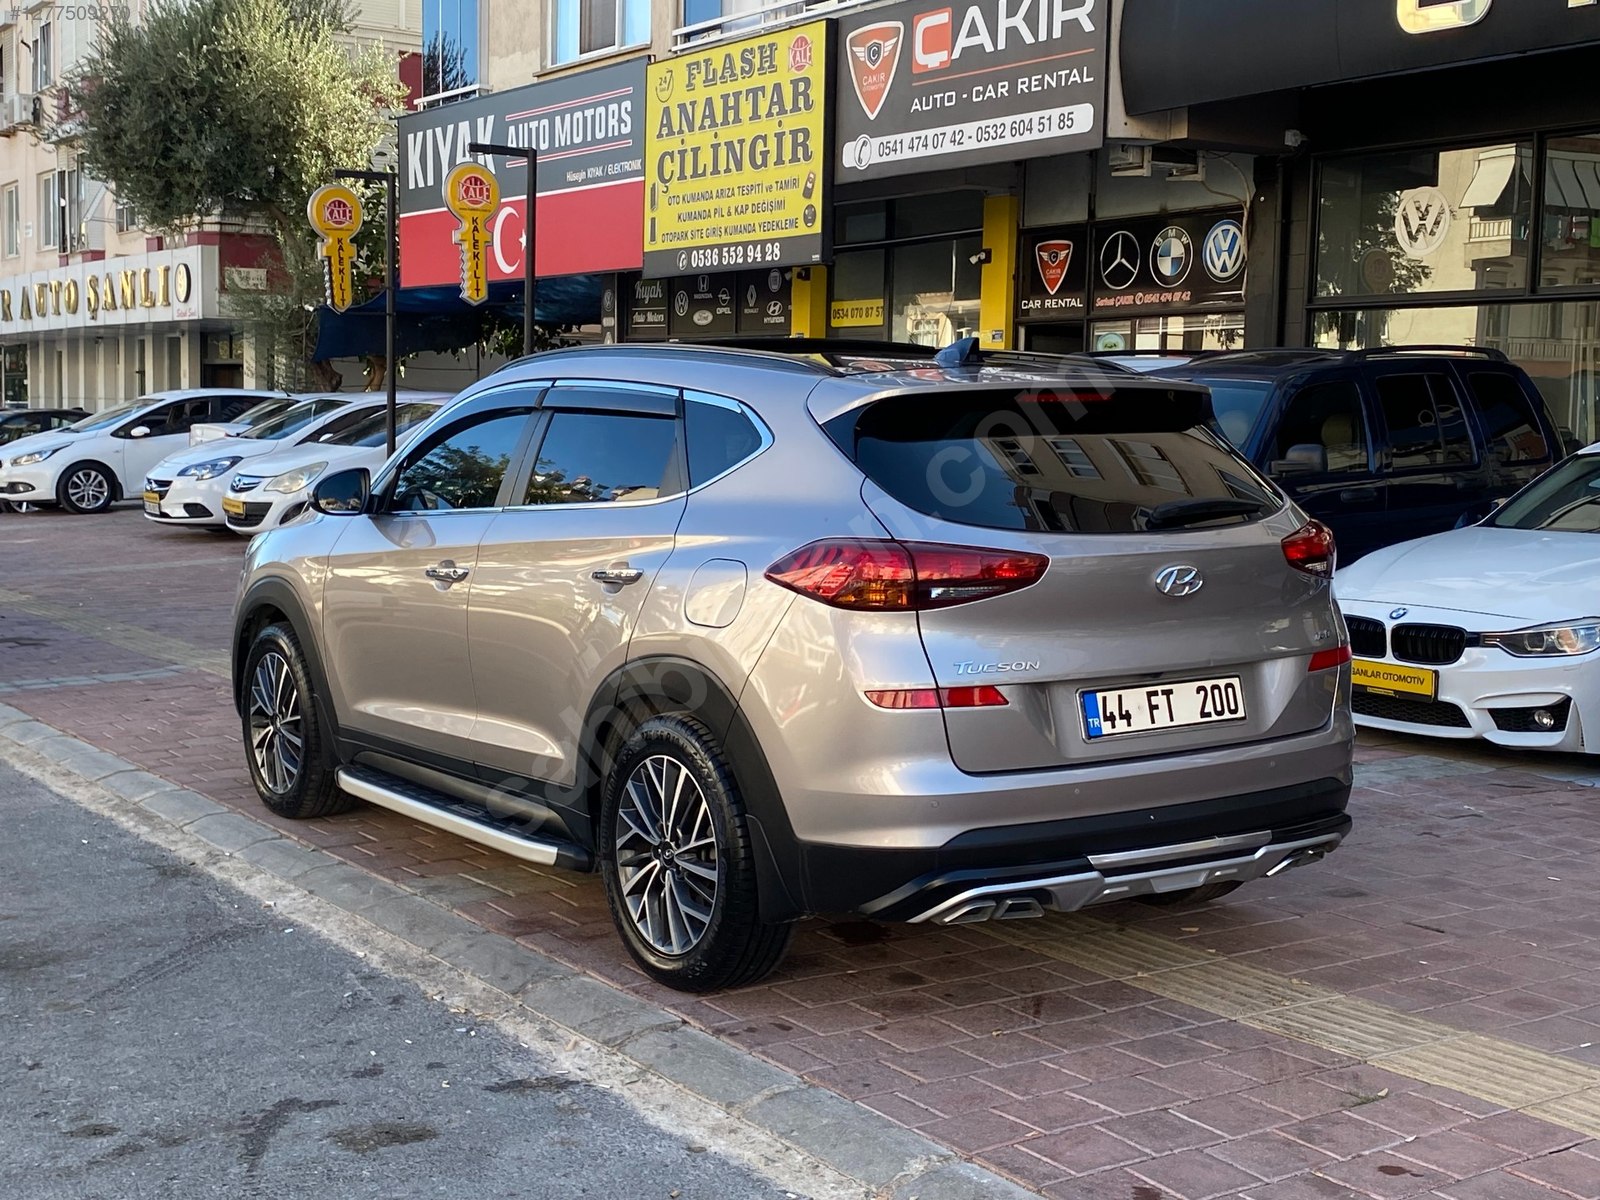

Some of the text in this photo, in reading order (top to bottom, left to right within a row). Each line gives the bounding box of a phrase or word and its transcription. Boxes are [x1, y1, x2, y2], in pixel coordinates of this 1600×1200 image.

[915, 0, 1095, 68] ÇAKIR
[686, 42, 778, 91] FLASH
[656, 76, 814, 139] ANAHTAR
[910, 91, 956, 113] AUTO
[972, 81, 1009, 102] CAR
[1017, 66, 1095, 94] RENTAL
[408, 100, 632, 189] KIYAK AUTO MOTORS
[878, 138, 904, 157] 0541
[908, 135, 928, 153] 474
[932, 132, 947, 149] 07
[949, 130, 965, 146] 42
[976, 122, 1006, 142] 0532
[1010, 119, 1033, 137] 604
[1037, 115, 1053, 133] 51
[1058, 111, 1074, 130] 85
[657, 120, 813, 193] ÇİLİNGİR
[459, 182, 490, 203] KALE
[667, 195, 680, 206] OTO
[682, 190, 714, 204] KUMANDA
[715, 187, 735, 200] ARIZA
[737, 182, 763, 196] TESPİTİ
[775, 176, 800, 190] TAMİRİ
[324, 206, 352, 222] KALE
[661, 230, 689, 243] OTOPARK
[724, 223, 756, 236] KUMANDA
[758, 218, 799, 232] YEDEKLEME
[677, 209, 711, 222] KUMANDA
[713, 206, 724, 218] PİL
[726, 206, 732, 216] &
[734, 204, 749, 215] KAP
[691, 242, 781, 267] 0536 552 94 28
[20, 278, 78, 320] AUTO
[832, 308, 849, 320] 0534
[850, 307, 864, 318] 070
[865, 306, 874, 318] 87
[1021, 298, 1083, 309] CAR RENTAL
[953, 660, 1040, 676] TUCSON
[1088, 682, 1239, 729] TR 44 FT 200
